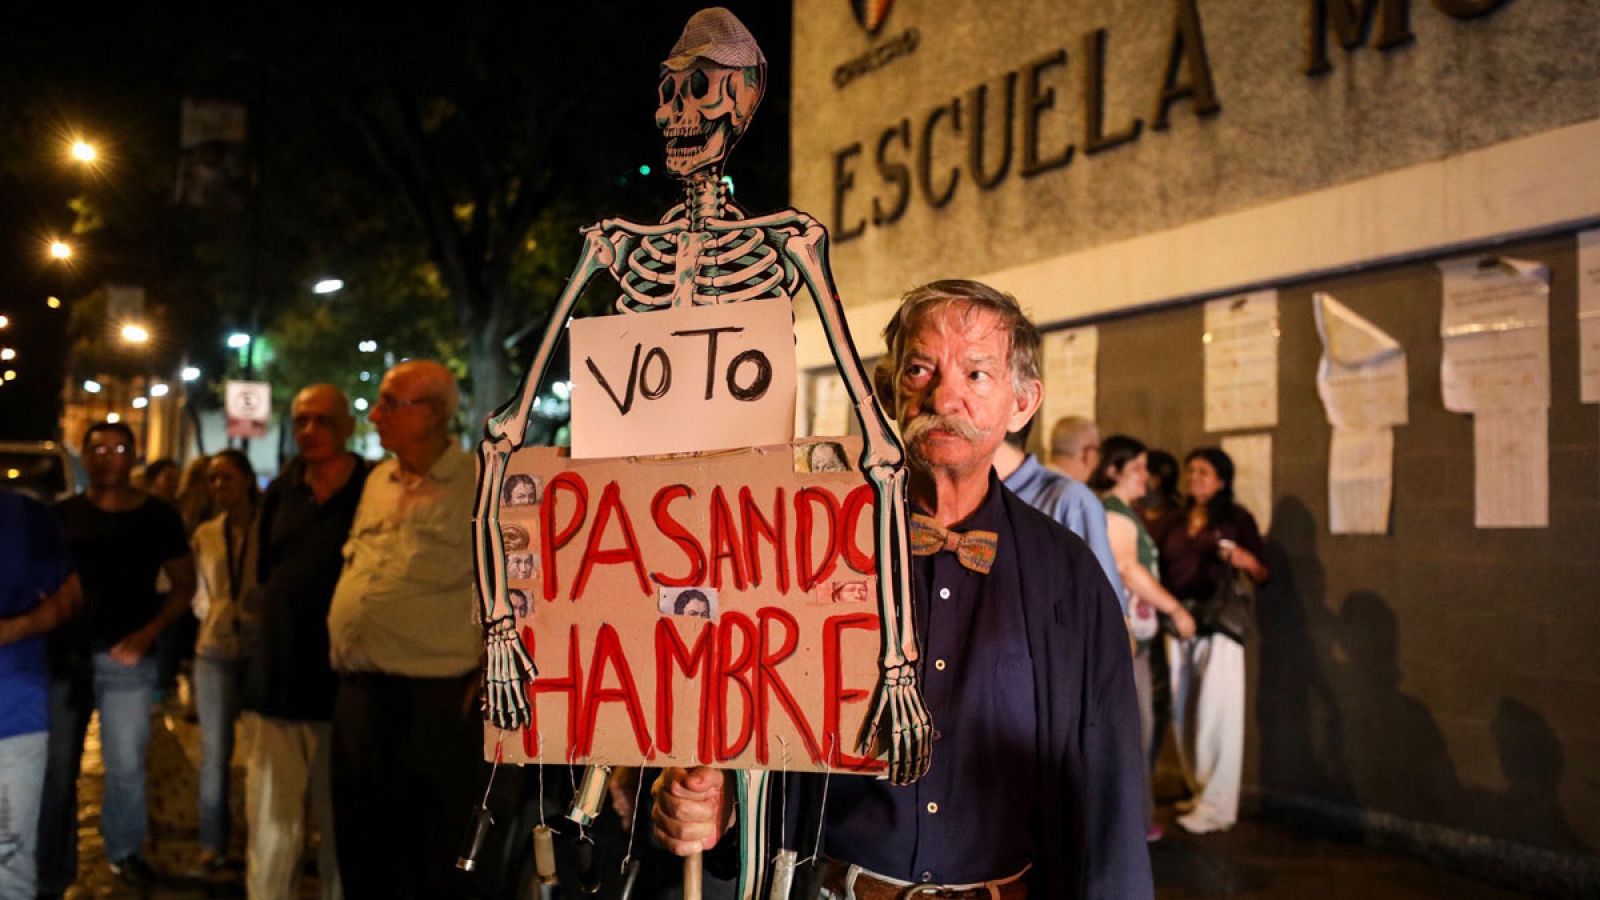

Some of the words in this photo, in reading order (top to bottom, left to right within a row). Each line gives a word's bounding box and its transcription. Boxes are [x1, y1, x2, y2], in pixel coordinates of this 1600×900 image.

[832, 0, 1221, 243] ESCUELA
[1303, 0, 1515, 78] M
[585, 326, 772, 416] VOTO
[540, 471, 876, 603] PASANDO
[522, 606, 890, 772] HAMBRE
